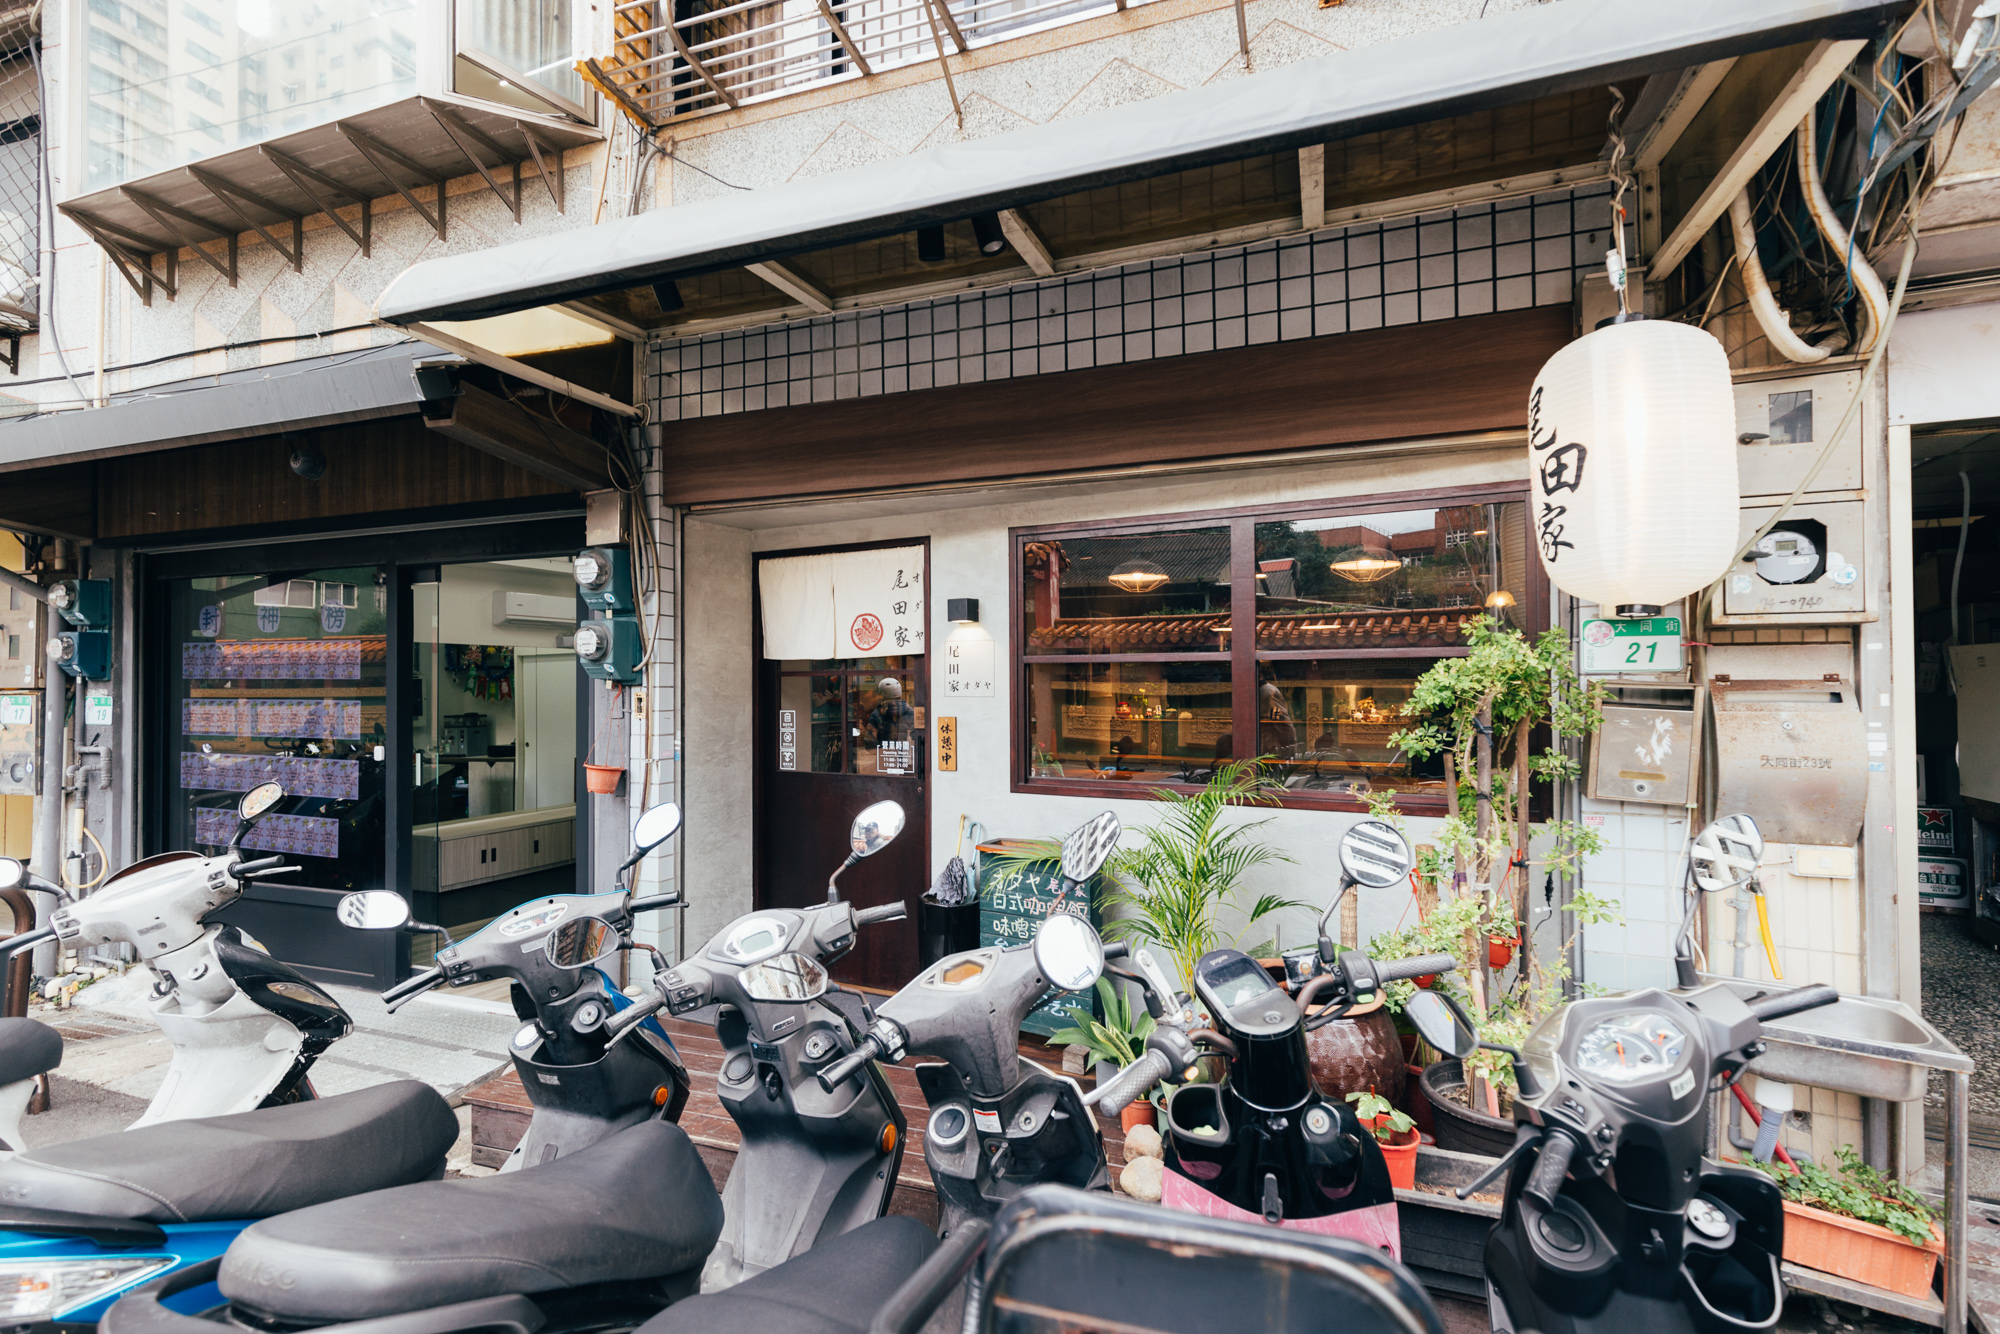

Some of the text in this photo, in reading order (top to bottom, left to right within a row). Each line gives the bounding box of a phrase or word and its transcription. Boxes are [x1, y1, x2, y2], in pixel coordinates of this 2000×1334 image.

[1531, 386, 1587, 562] 尾田家
[892, 570, 910, 647] 尾田家
[202, 607, 344, 633] 封神榜
[1615, 620, 1678, 633] 大同街
[1625, 641, 1658, 663] 21
[14, 708, 25, 720] 17
[97, 709, 107, 721] 19
[940, 723, 953, 766] 休憩中
[1761, 755, 1832, 769] 大同街23號
[1045, 877, 1087, 898] 尾家
